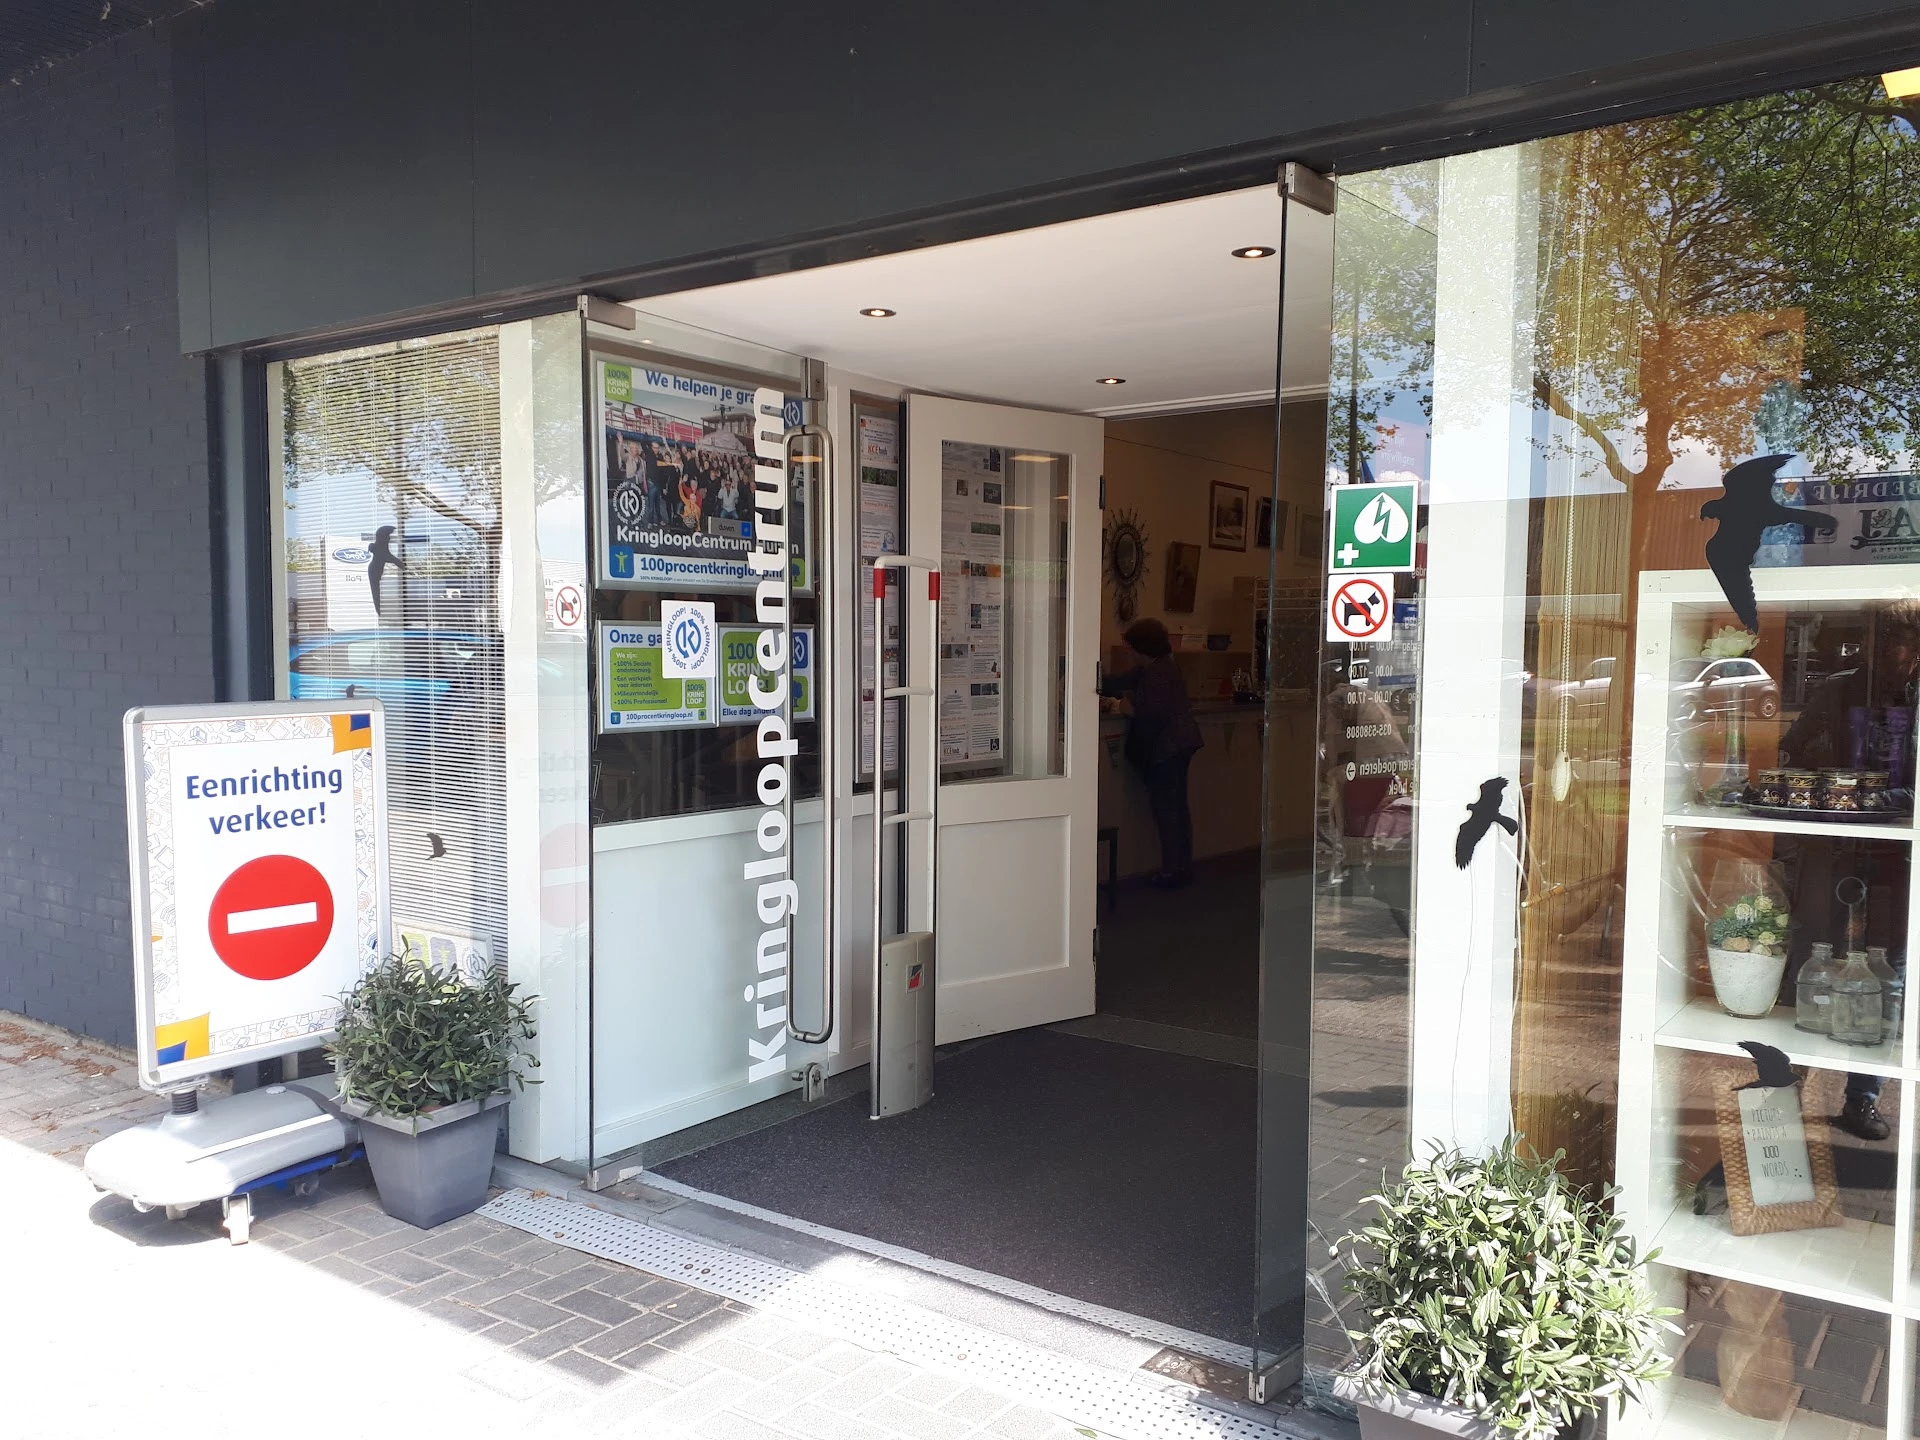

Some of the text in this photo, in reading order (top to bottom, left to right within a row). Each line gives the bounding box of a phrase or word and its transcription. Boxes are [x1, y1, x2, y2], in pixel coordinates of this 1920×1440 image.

[606, 377, 630, 390] KRING
[645, 369, 669, 388] We
[673, 373, 717, 397] helpen
[720, 384, 733, 402] je
[616, 524, 799, 555] KringloopCentrum Huin
[640, 557, 782, 580] 100procentkringlop.nl
[609, 629, 662, 647] Onze ga
[665, 606, 706, 653] KRINGLOOP! 100%
[615, 651, 625, 659] We
[671, 624, 711, 671] 100% KRINGLOOP!
[727, 642, 764, 660] 100
[727, 679, 769, 696] LOP!
[626, 711, 693, 721] 100procentkringloop.nl
[722, 708, 737, 716] Elke
[739, 708, 752, 717] dag
[186, 764, 343, 800] Eenrichting
[208, 800, 327, 835] verkeer!
[1751, 1107, 1782, 1123] PICTURE
[1762, 1145, 1780, 1159] 1000
[1761, 1161, 1790, 1177] WORDS
